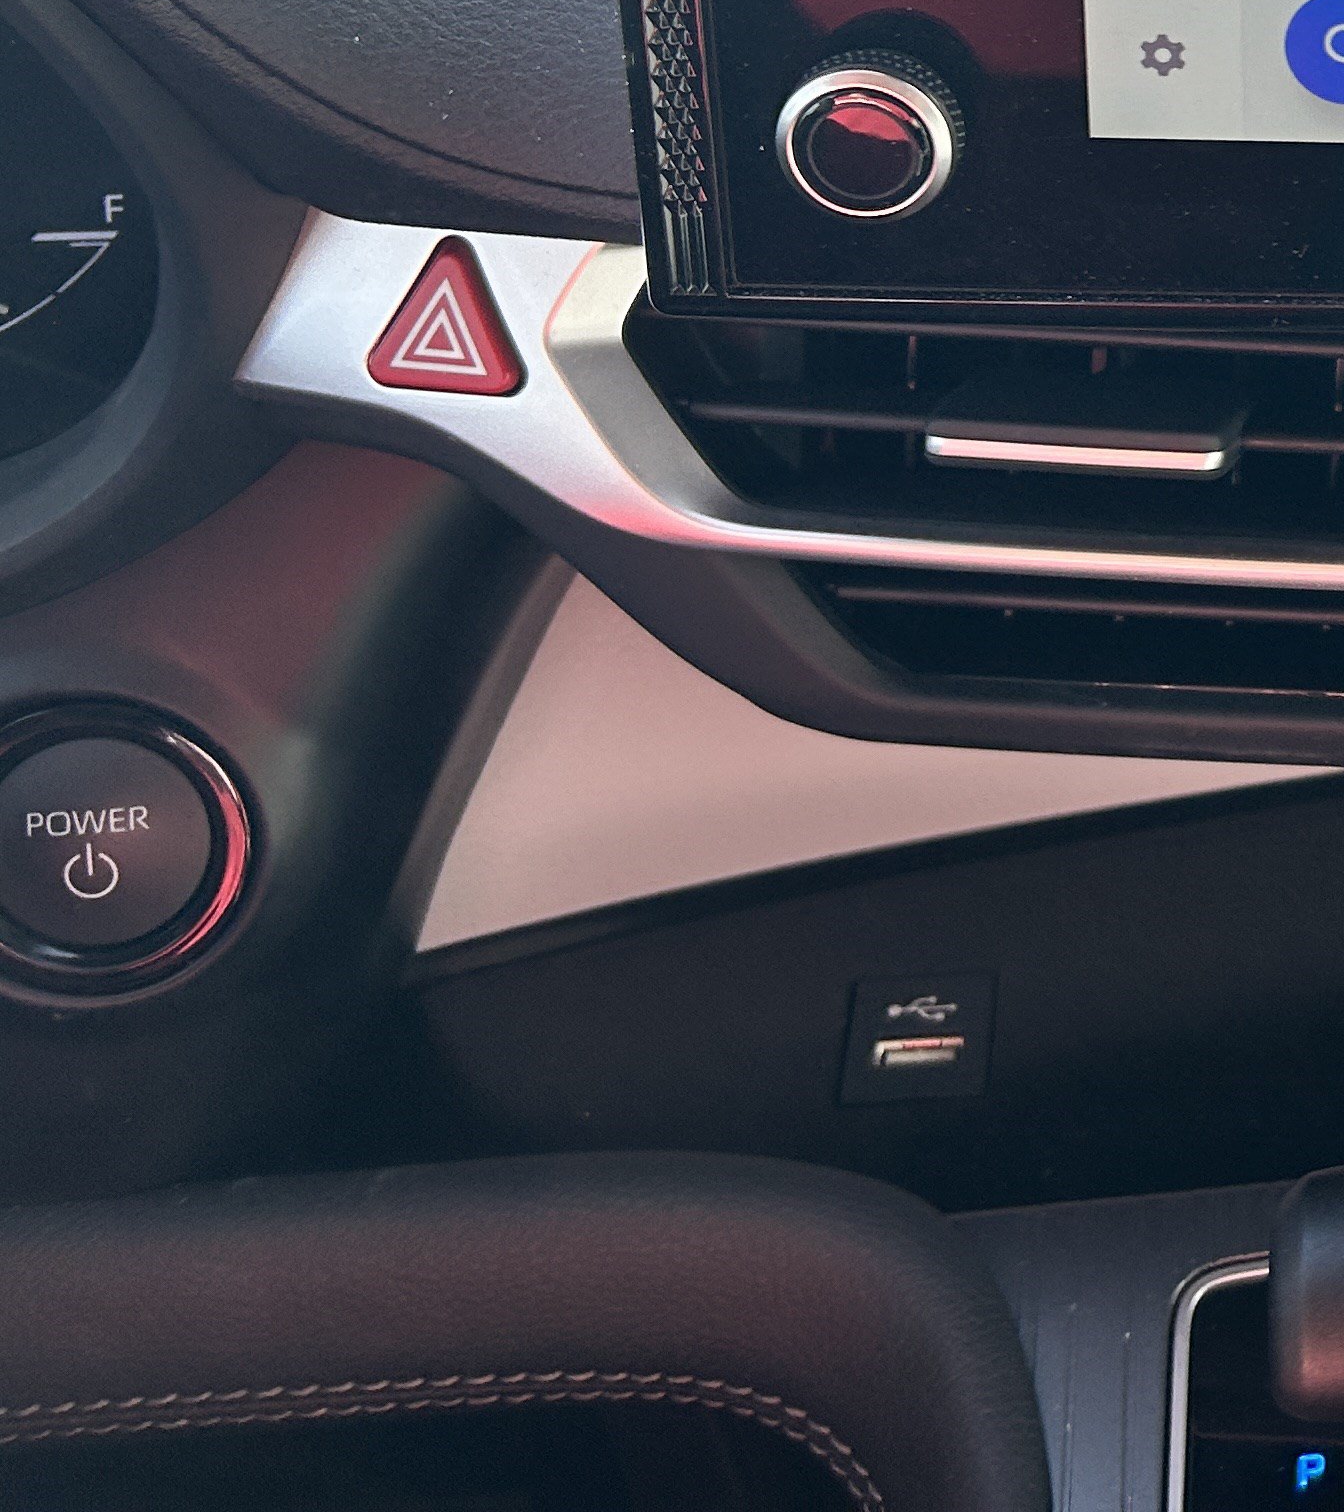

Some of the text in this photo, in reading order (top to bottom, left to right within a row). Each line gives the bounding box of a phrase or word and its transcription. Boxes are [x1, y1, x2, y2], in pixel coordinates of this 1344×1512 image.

[104, 193, 124, 223] F
[26, 805, 150, 838] POWER
[1294, 1452, 1327, 1490] P
